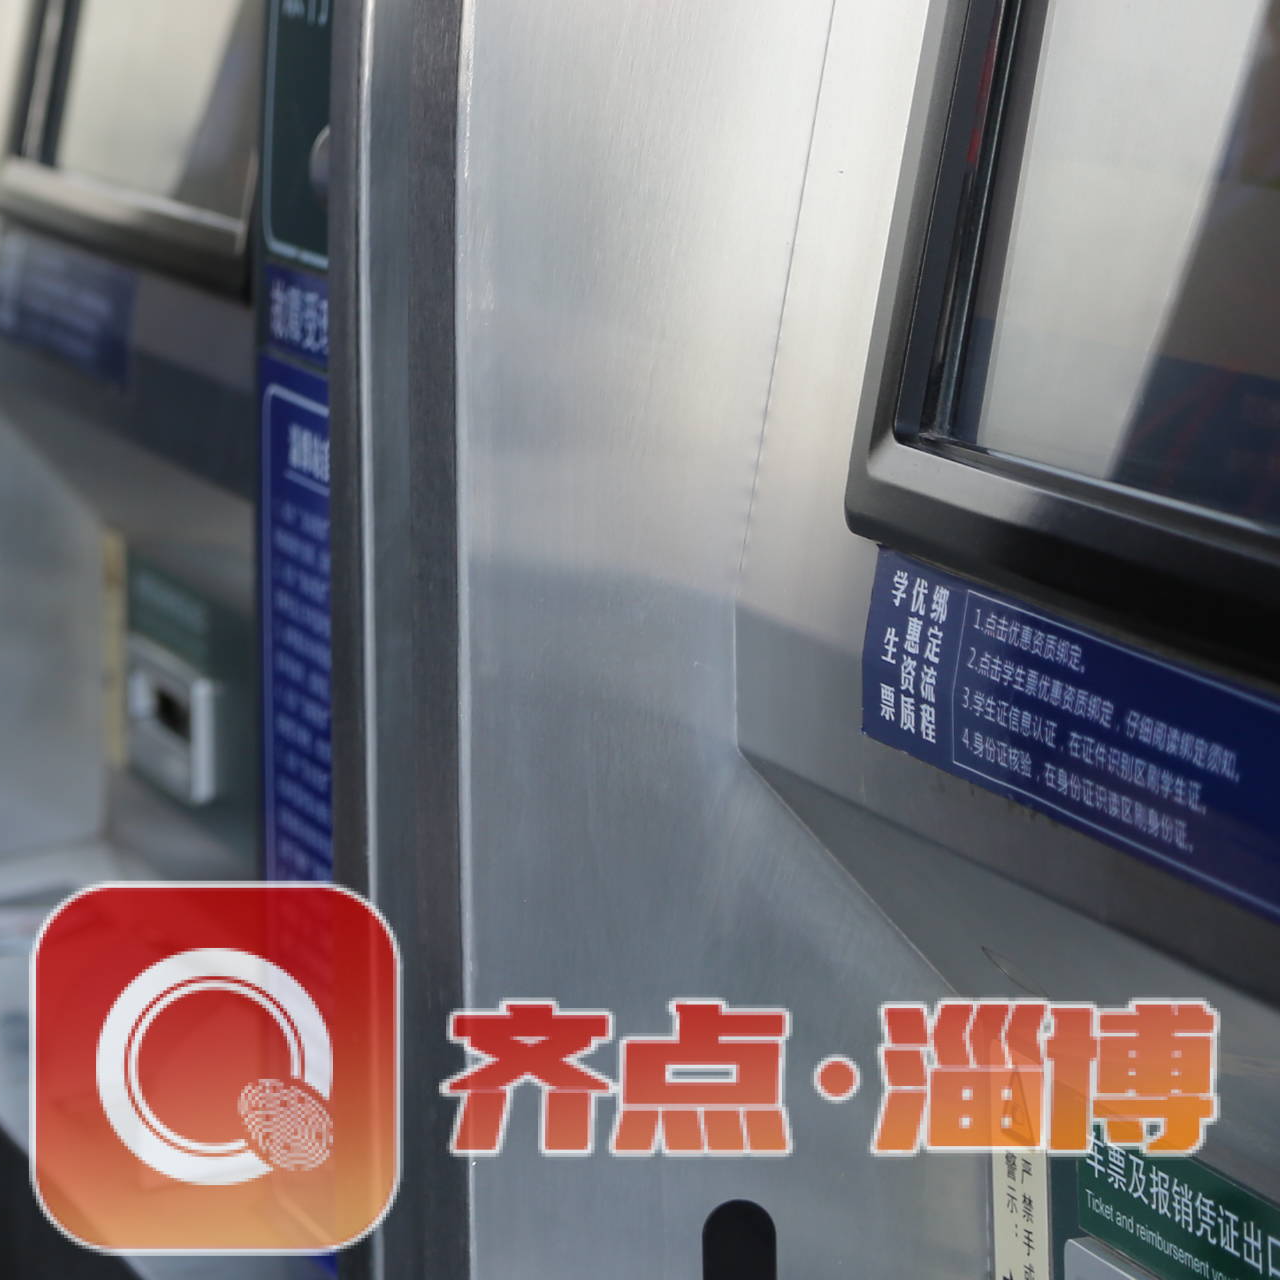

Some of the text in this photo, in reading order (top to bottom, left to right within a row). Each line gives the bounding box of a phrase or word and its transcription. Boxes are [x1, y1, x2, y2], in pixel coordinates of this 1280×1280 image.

[879, 570, 909, 722] 学生票
[900, 577, 928, 734] 优惠资质
[919, 584, 950, 744] 绑定流程
[1085, 1188, 1210, 1280] Ticket and reimbursement
